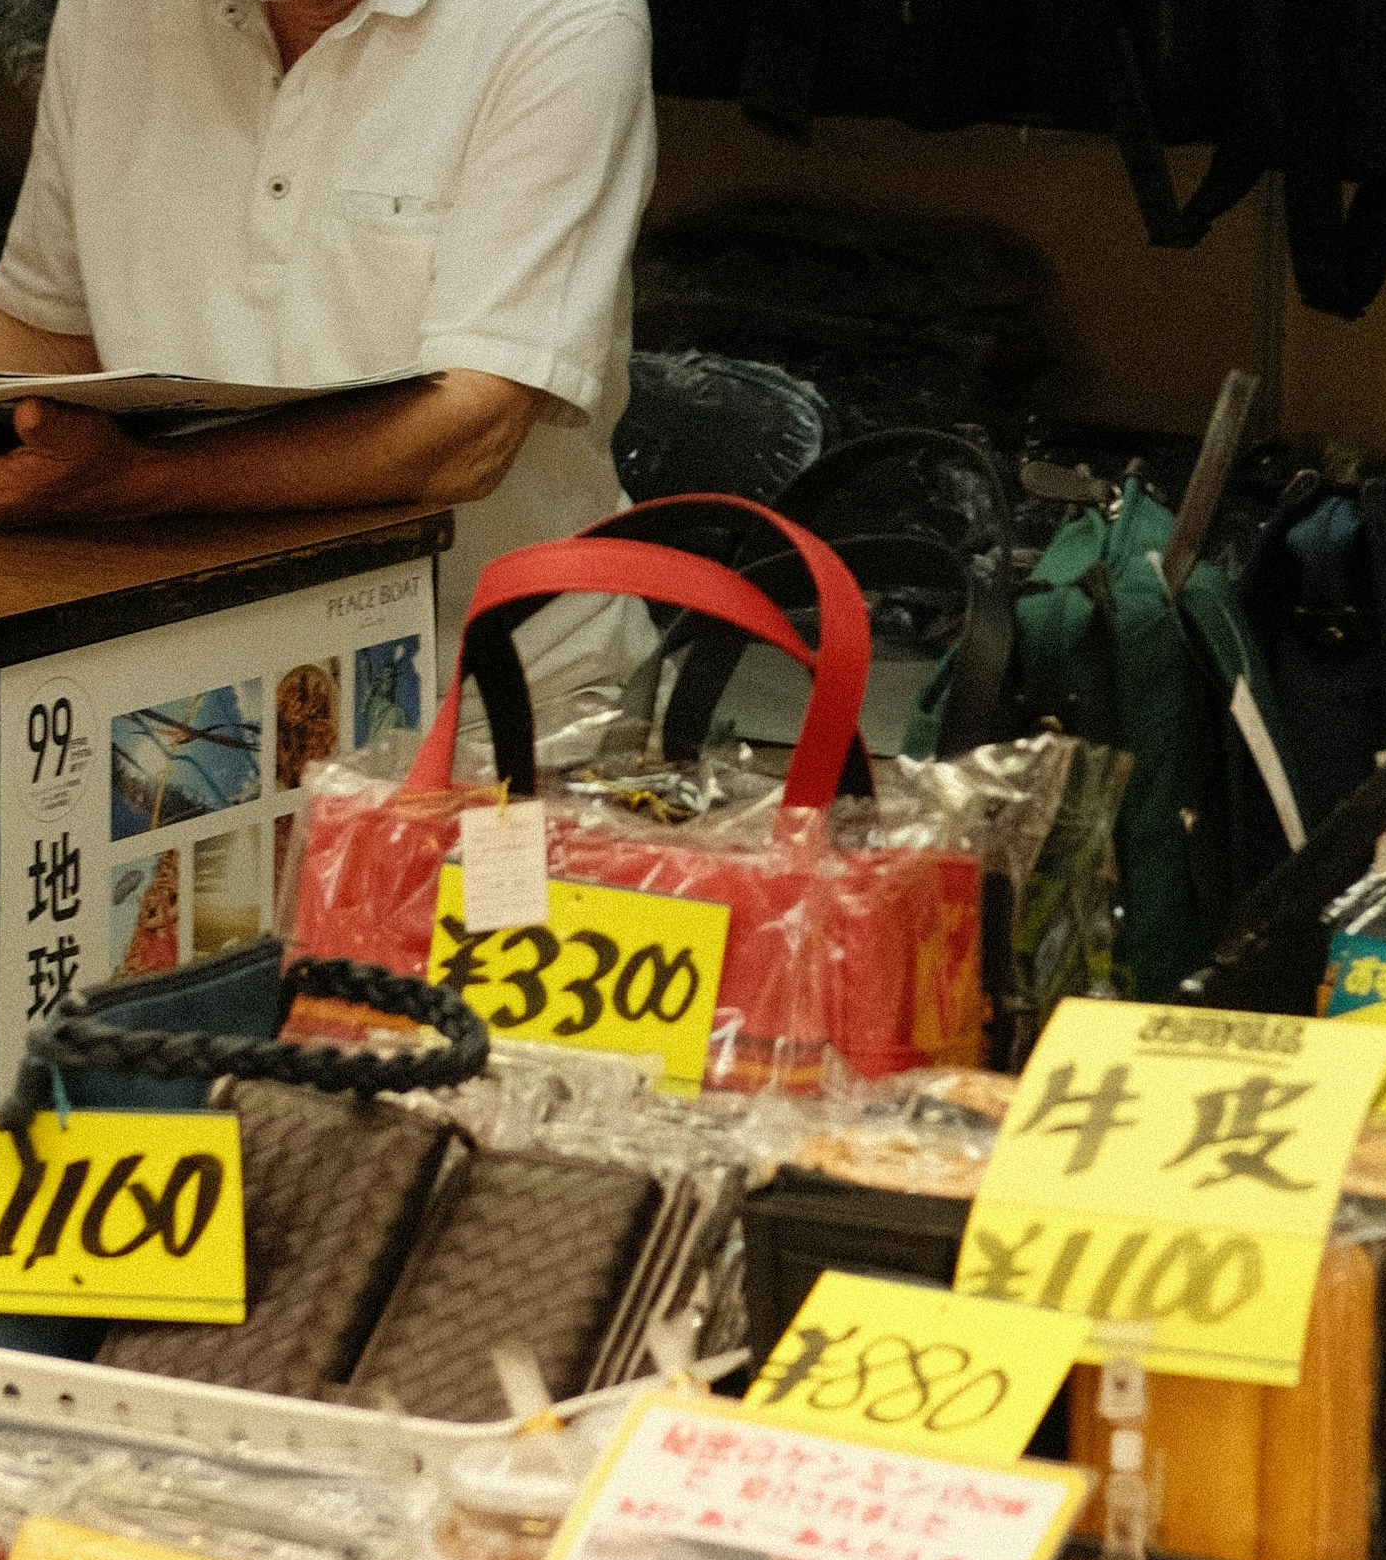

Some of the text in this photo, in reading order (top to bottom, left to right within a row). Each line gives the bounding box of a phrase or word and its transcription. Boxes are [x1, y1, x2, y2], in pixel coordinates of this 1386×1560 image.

[325, 576, 421, 618] PEACE BOAT
[27, 696, 74, 784] 99
[26, 832, 82, 1021] 地球
[437, 913, 702, 1038] ¥3300
[1010, 1061, 1320, 1194] 牛皮
[759, 1323, 1011, 1434] ¥880
